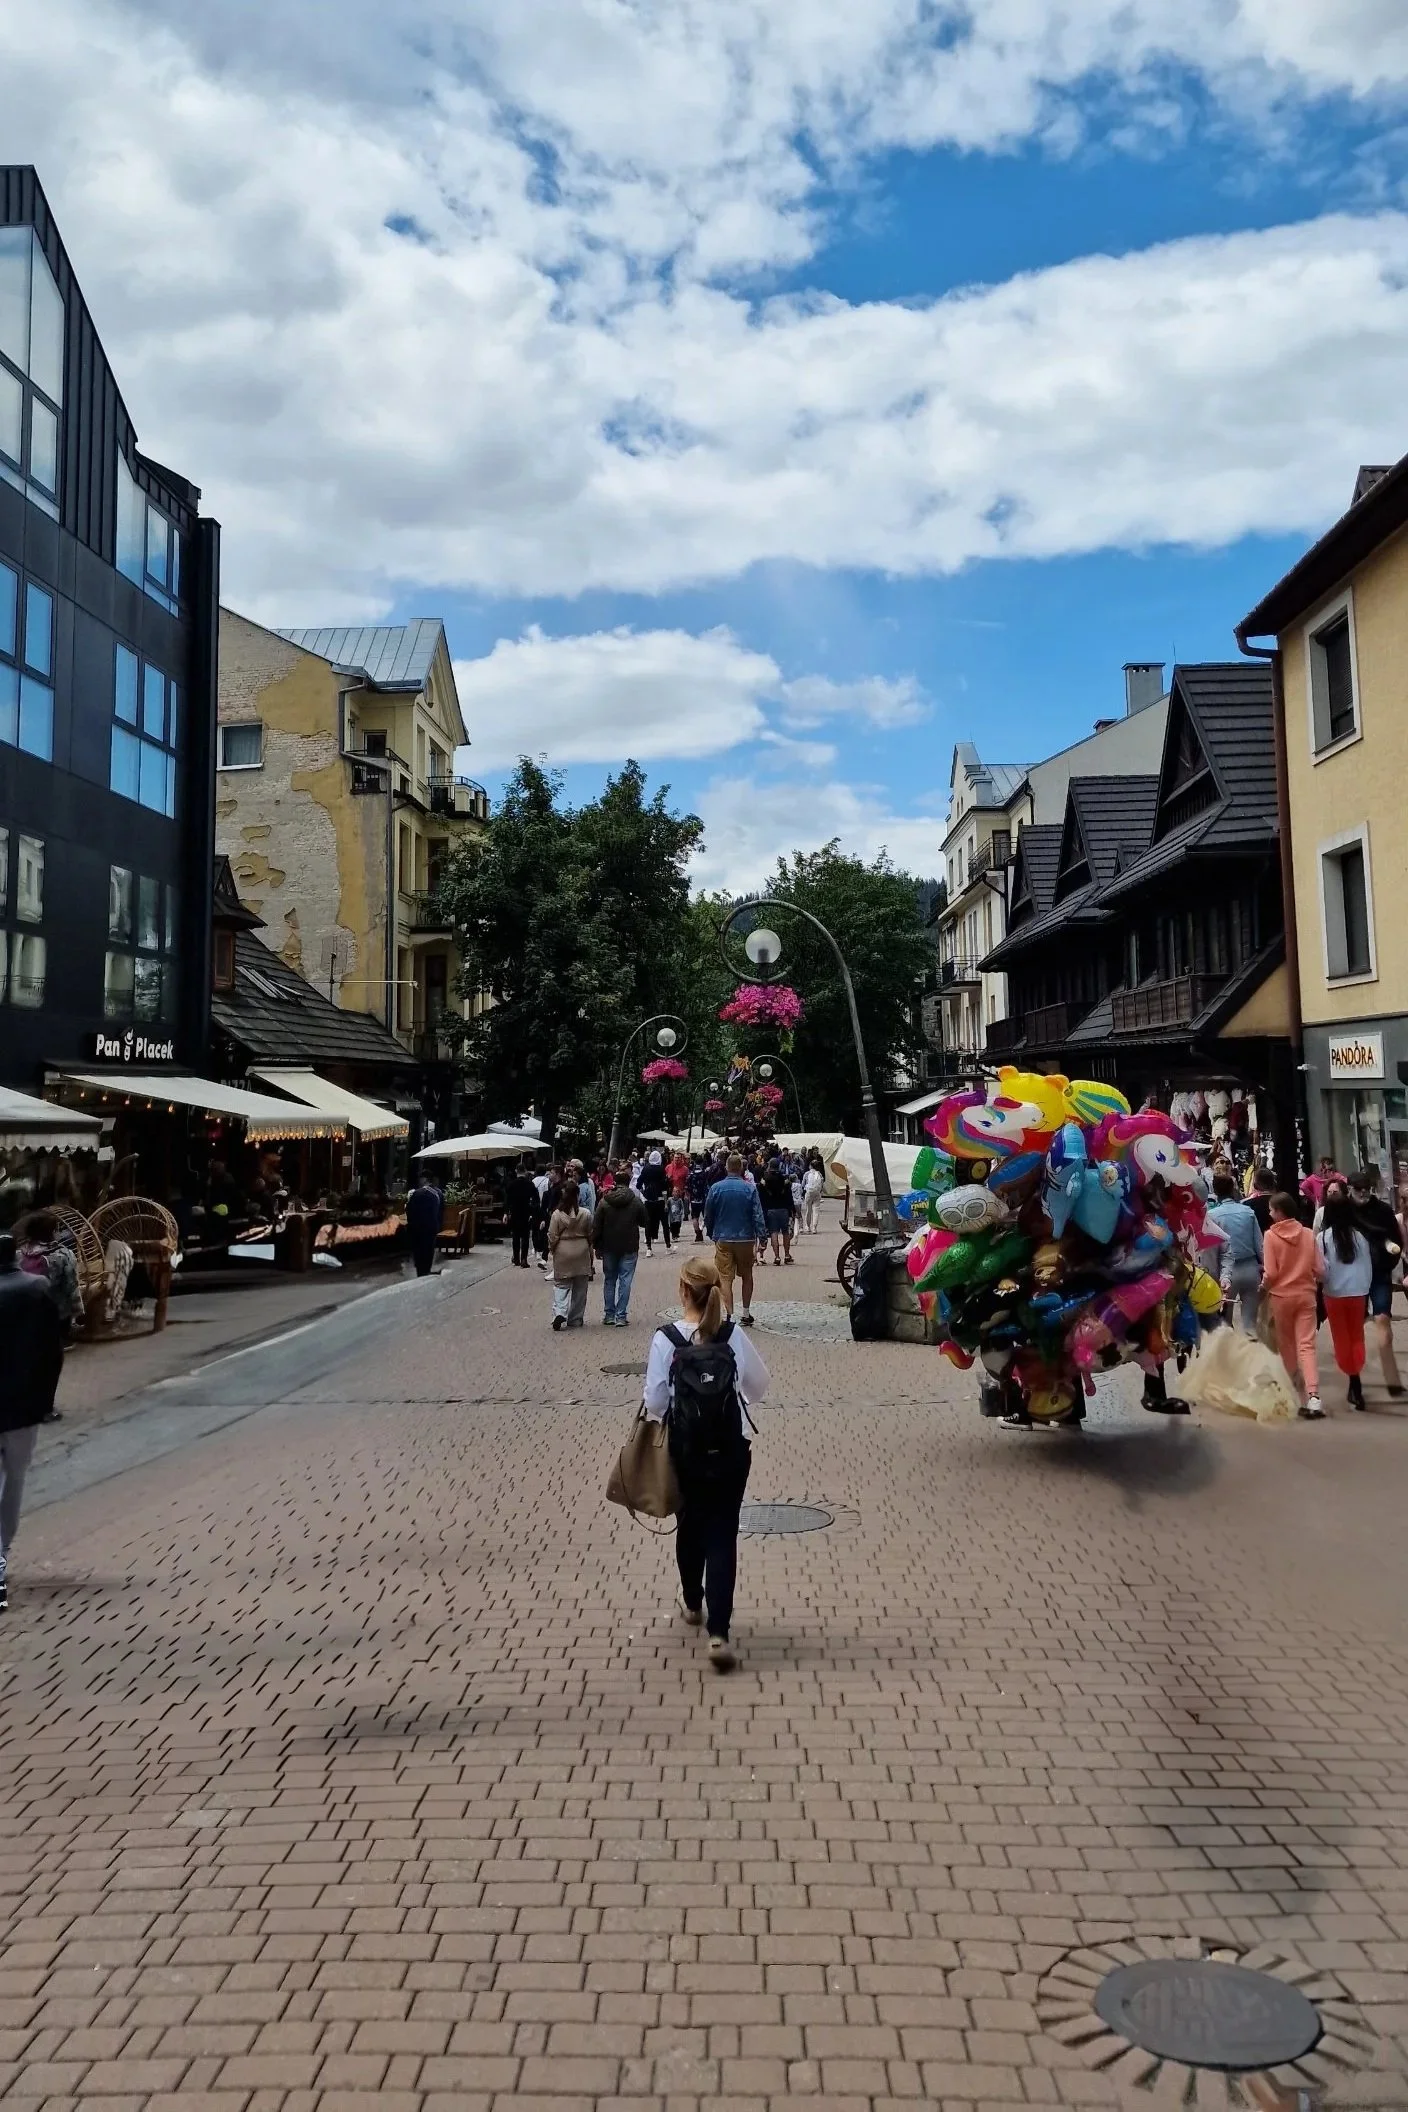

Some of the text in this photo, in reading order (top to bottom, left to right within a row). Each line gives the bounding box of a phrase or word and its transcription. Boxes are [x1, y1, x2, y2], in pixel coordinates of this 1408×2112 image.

[95, 1033, 173, 1060] Pan Placek
[1331, 1043, 1374, 1066] PANDORA
